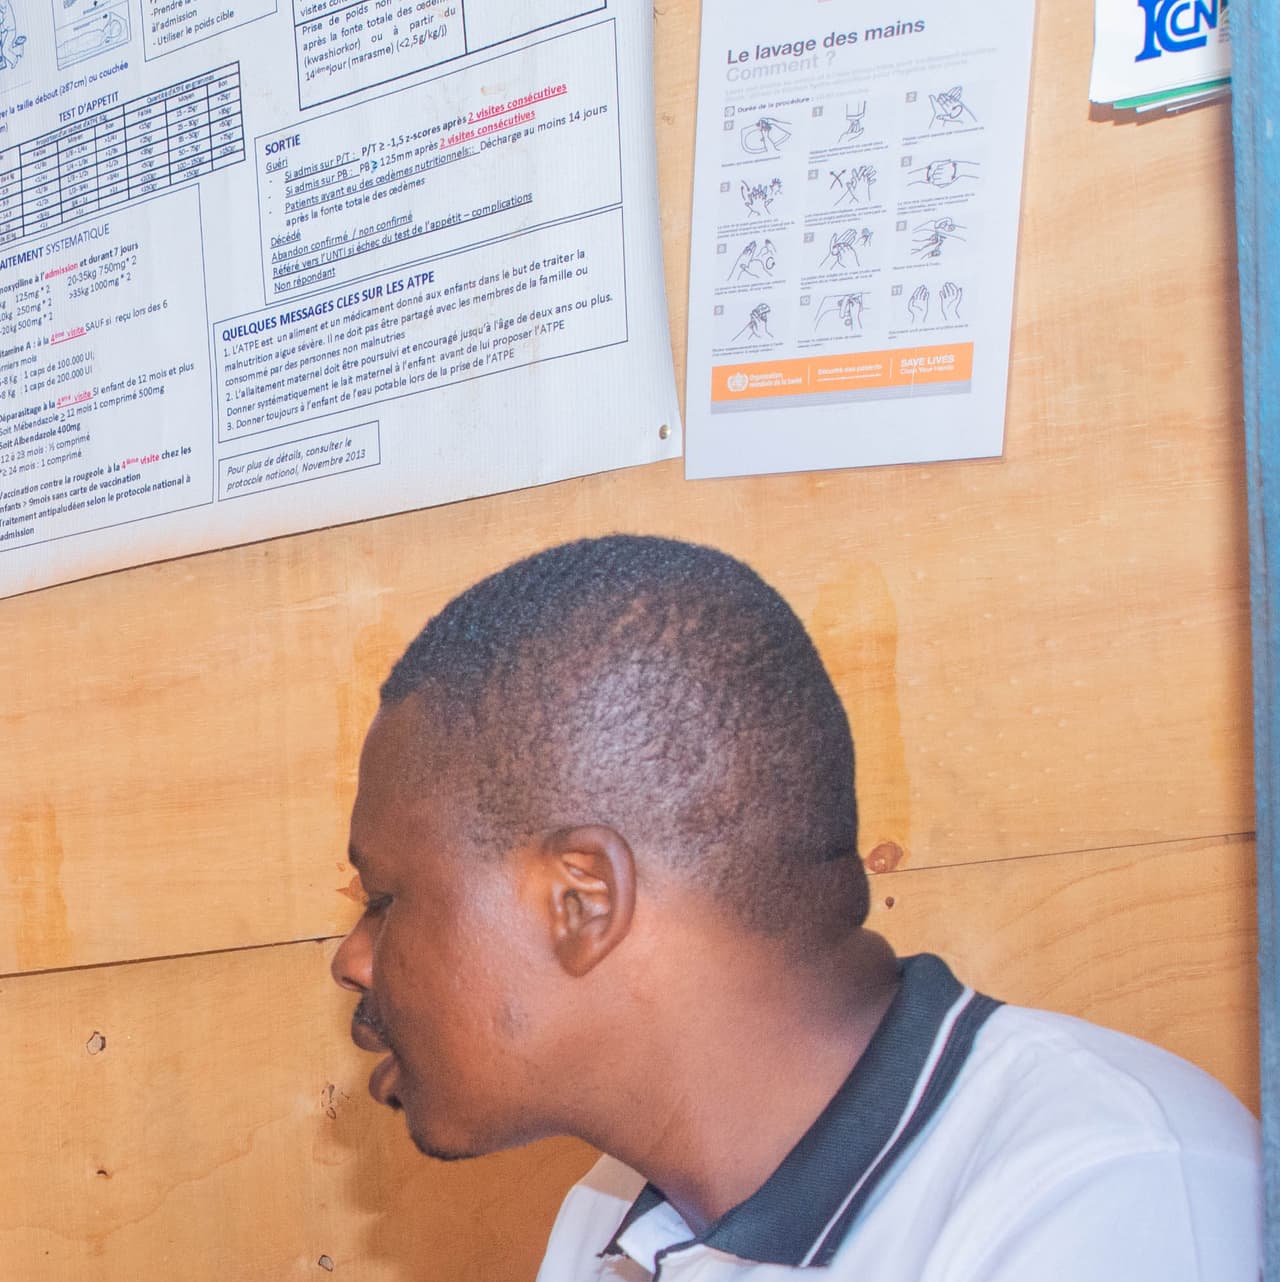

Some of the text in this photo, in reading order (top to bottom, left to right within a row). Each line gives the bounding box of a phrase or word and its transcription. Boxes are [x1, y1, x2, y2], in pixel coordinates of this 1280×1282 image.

[303, 6, 412, 51] après la fonte totale des
[727, 18, 926, 65] Le lavage des mains
[726, 54, 819, 83] Comment
[826, 50, 837, 67] ?
[58, 107, 75, 122] TEST
[293, 163, 317, 177] admis
[319, 159, 333, 169] sur
[335, 151, 349, 168] P/T
[361, 143, 376, 156] P/T
[442, 116, 466, 131] après
[467, 111, 474, 124] 2
[474, 104, 505, 122] visites
[505, 83, 567, 112] consécutives
[265, 133, 300, 155] SORTIE
[286, 212, 308, 227] après
[311, 209, 318, 219] la
[320, 203, 342, 216] fonte
[345, 193, 369, 208] totale
[372, 190, 387, 200] des
[45, 222, 109, 255] SYSTEMATIQUE
[271, 211, 412, 262] Abandon confirmé non confirmé
[274, 267, 335, 292] Non répondant
[222, 270, 434, 341] QUELQUES MESSAGES CLES SUR LES ATPE
[901, 354, 955, 367] SAVE LIVES
[236, 415, 264, 428] Donner
[265, 406, 298, 421] toujours
[340, 391, 350, 401] de
[374, 376, 406, 395] potable
[409, 373, 424, 384] lors
[426, 368, 437, 379] de
[439, 366, 447, 376] la
[450, 361, 470, 376] prise
[472, 357, 483, 367] de
[226, 473, 262, 492] protocole
[302, 456, 343, 471] Novembre
[345, 448, 365, 462] 2013
